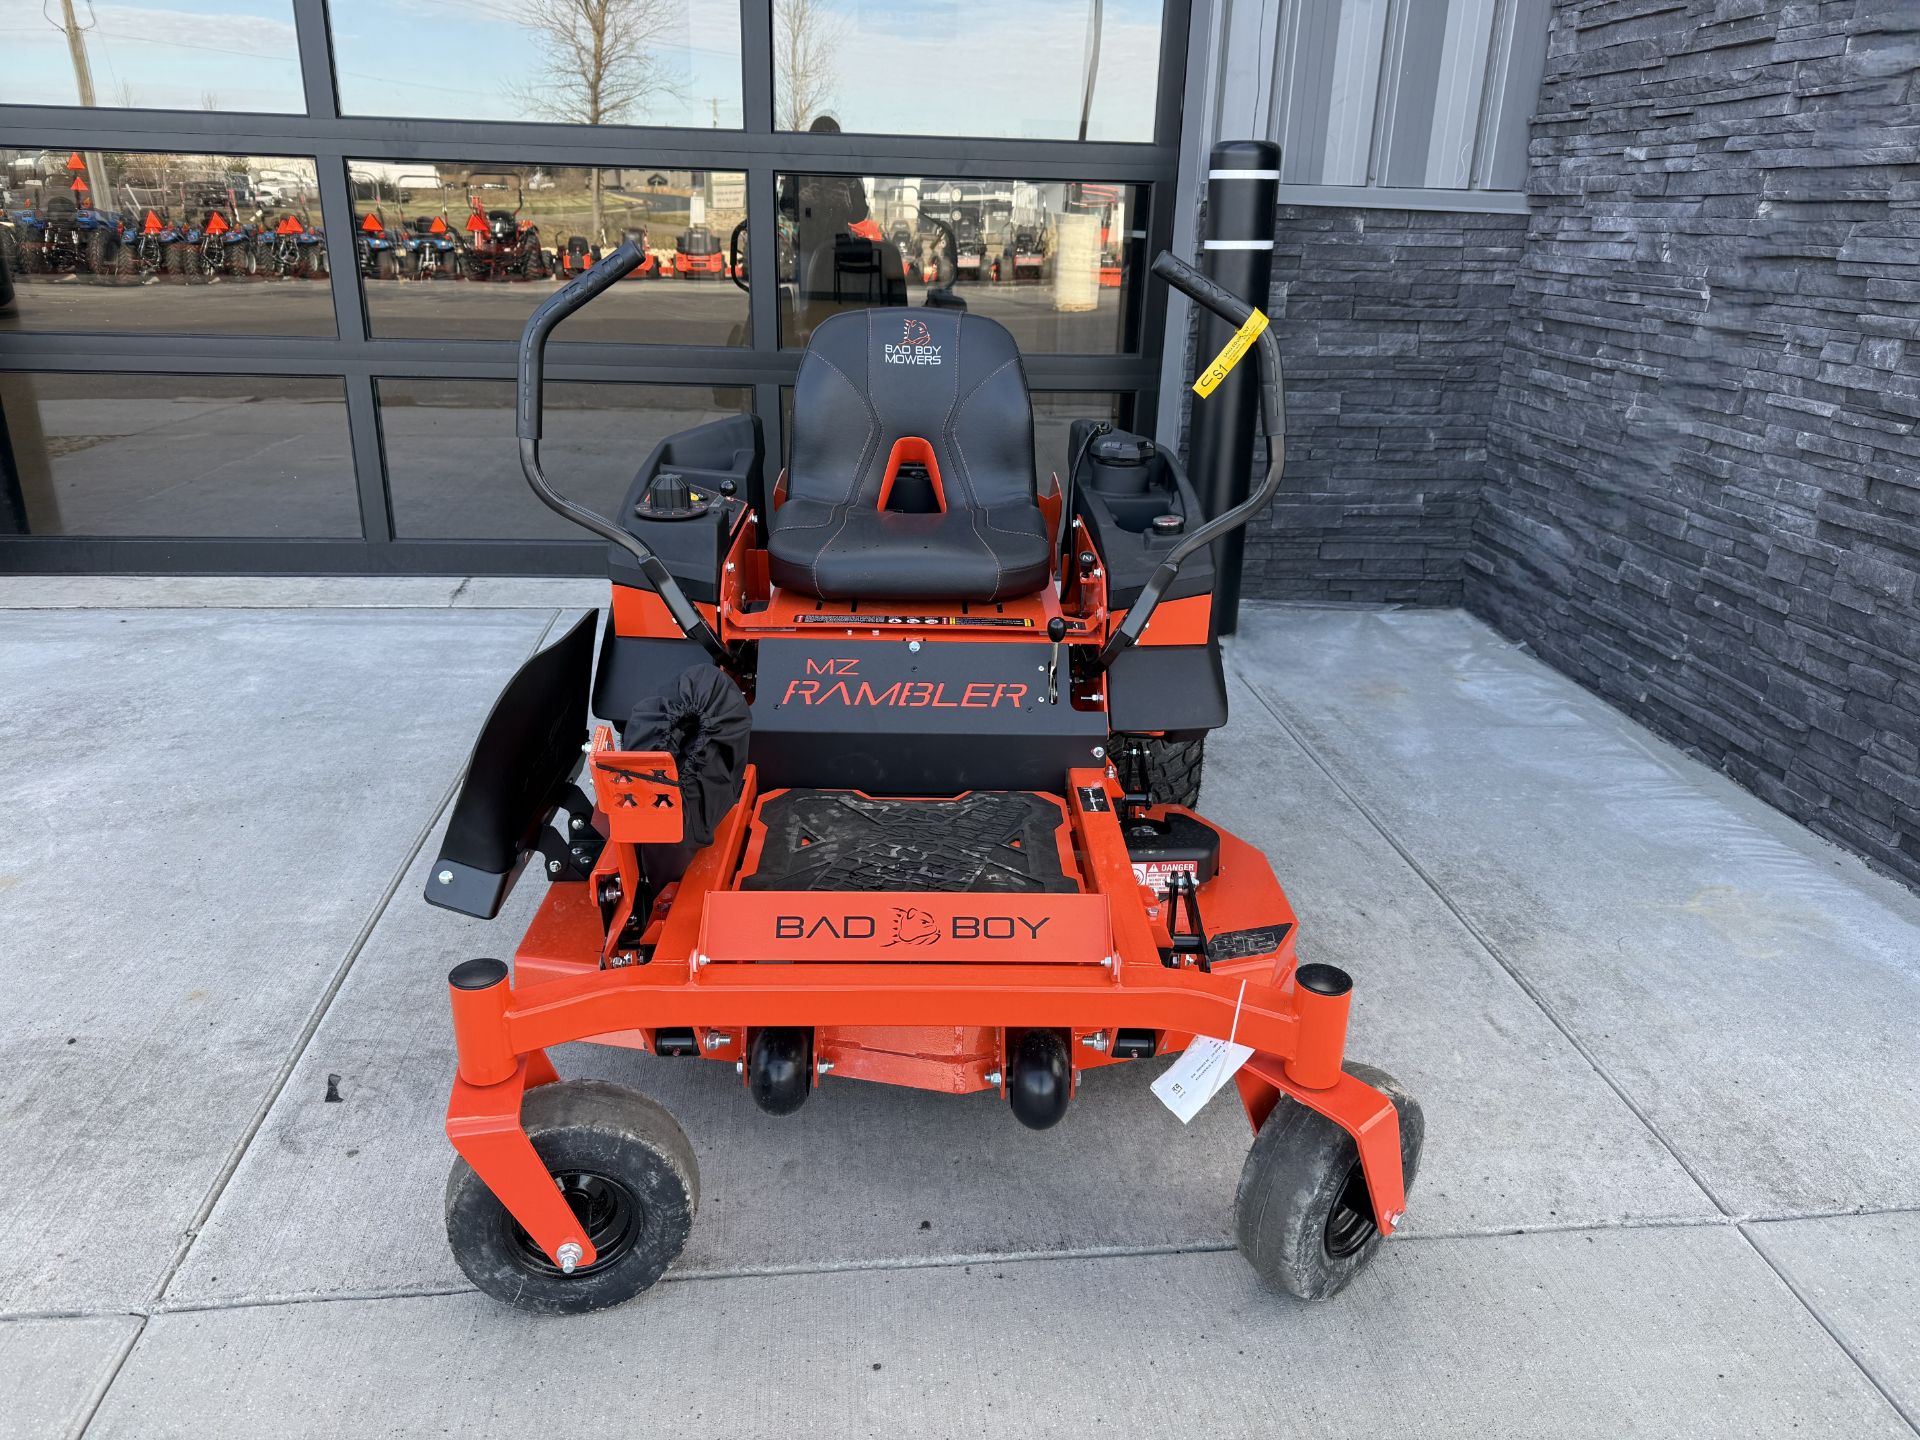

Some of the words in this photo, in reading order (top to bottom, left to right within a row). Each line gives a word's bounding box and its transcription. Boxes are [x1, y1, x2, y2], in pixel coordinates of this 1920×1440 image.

[561, 253, 625, 305] BAD
[885, 344, 911, 355] BAD
[915, 345, 941, 356] BOY
[885, 353, 941, 365] MOWERS
[806, 658, 860, 676] MZ
[782, 680, 1028, 709] RAMBLER
[1161, 864, 1194, 872] DANGER
[775, 915, 876, 939] BAD
[952, 916, 1051, 940] BOY
